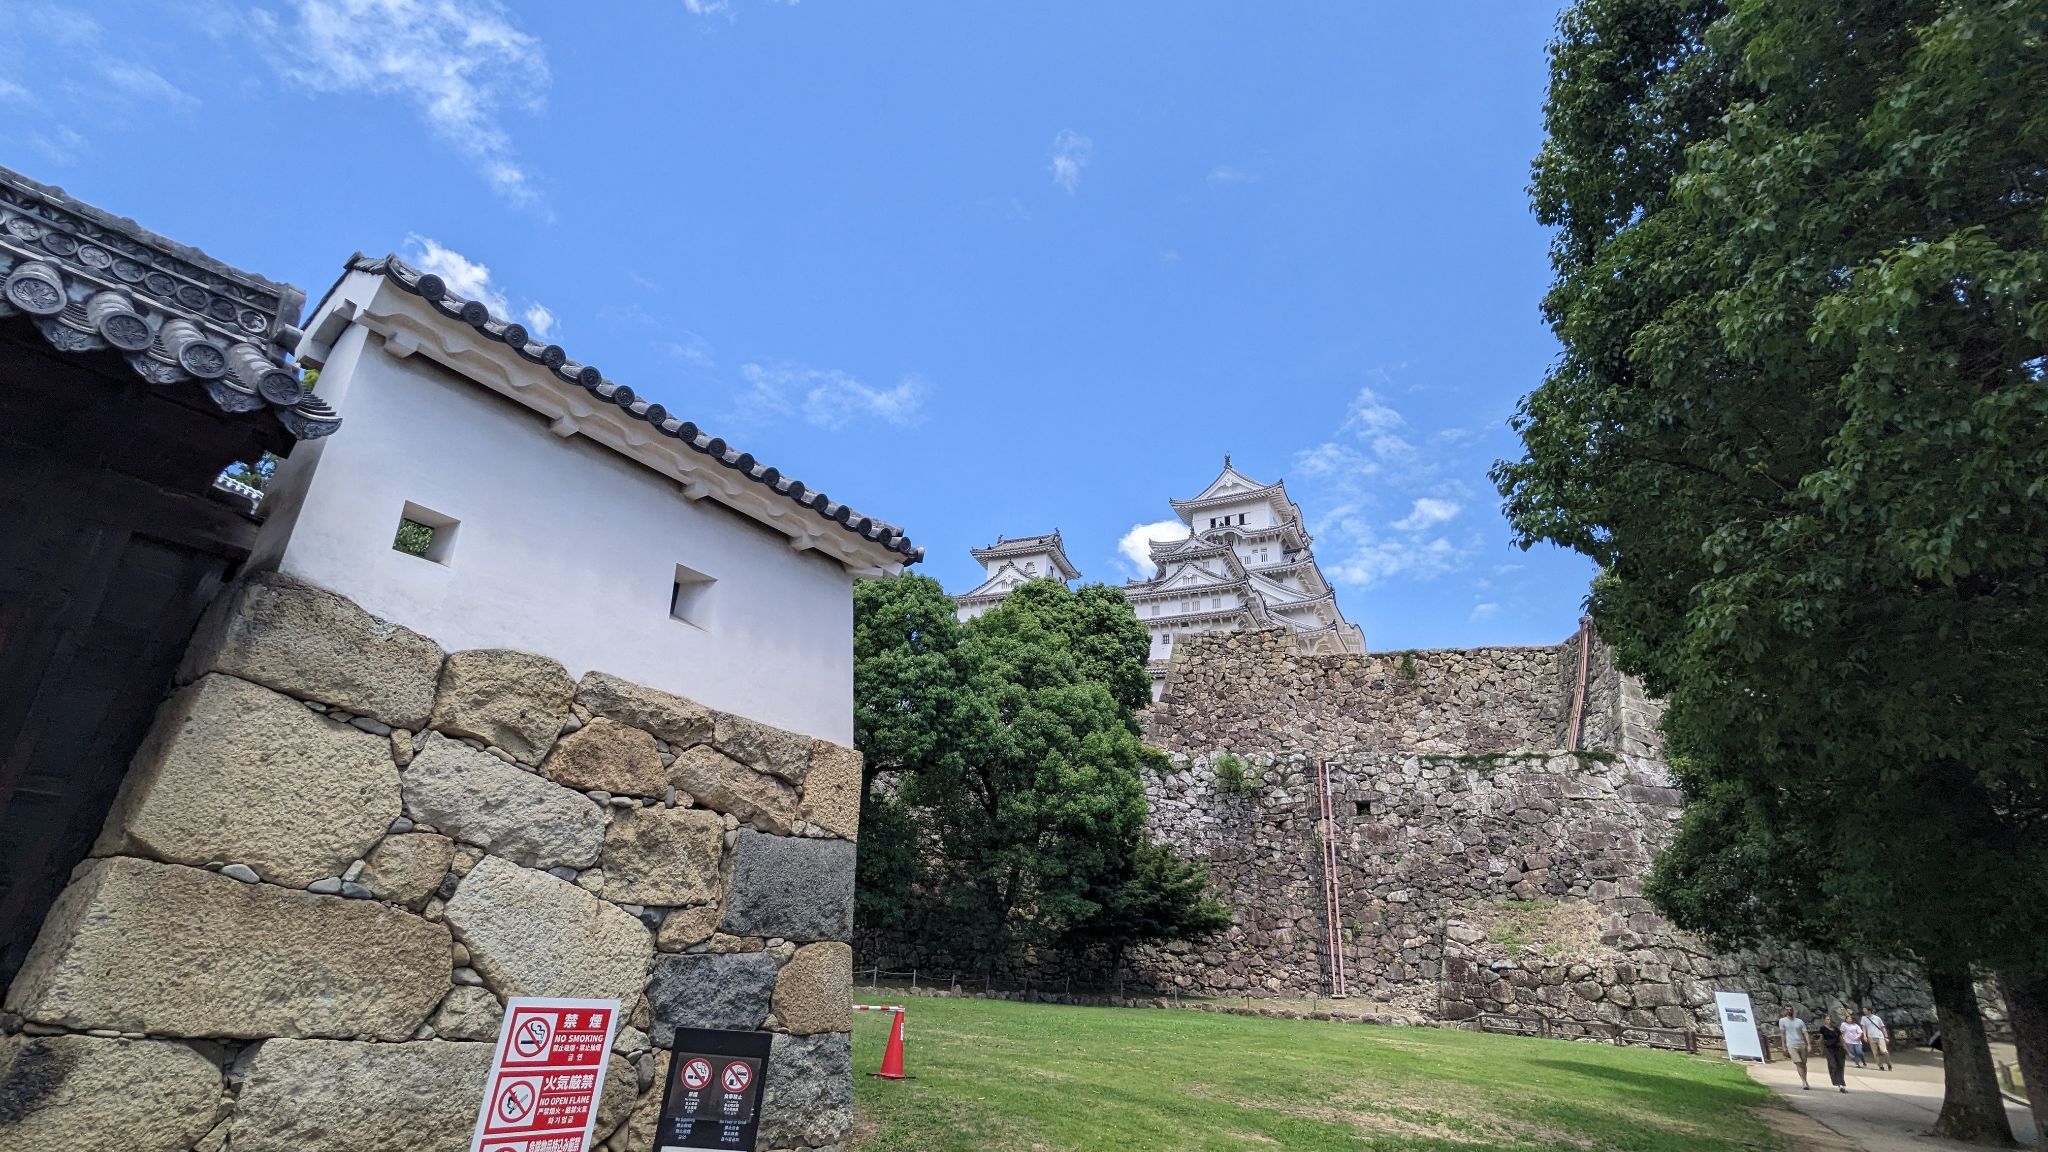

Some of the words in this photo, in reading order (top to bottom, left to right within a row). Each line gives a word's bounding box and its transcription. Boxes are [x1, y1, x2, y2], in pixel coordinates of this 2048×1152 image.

[564, 1014, 603, 1028] 禁煙
[543, 1074, 594, 1090] 火気厳禁
[539, 1098, 550, 1106] NO
[569, 1096, 590, 1104] FLAME
